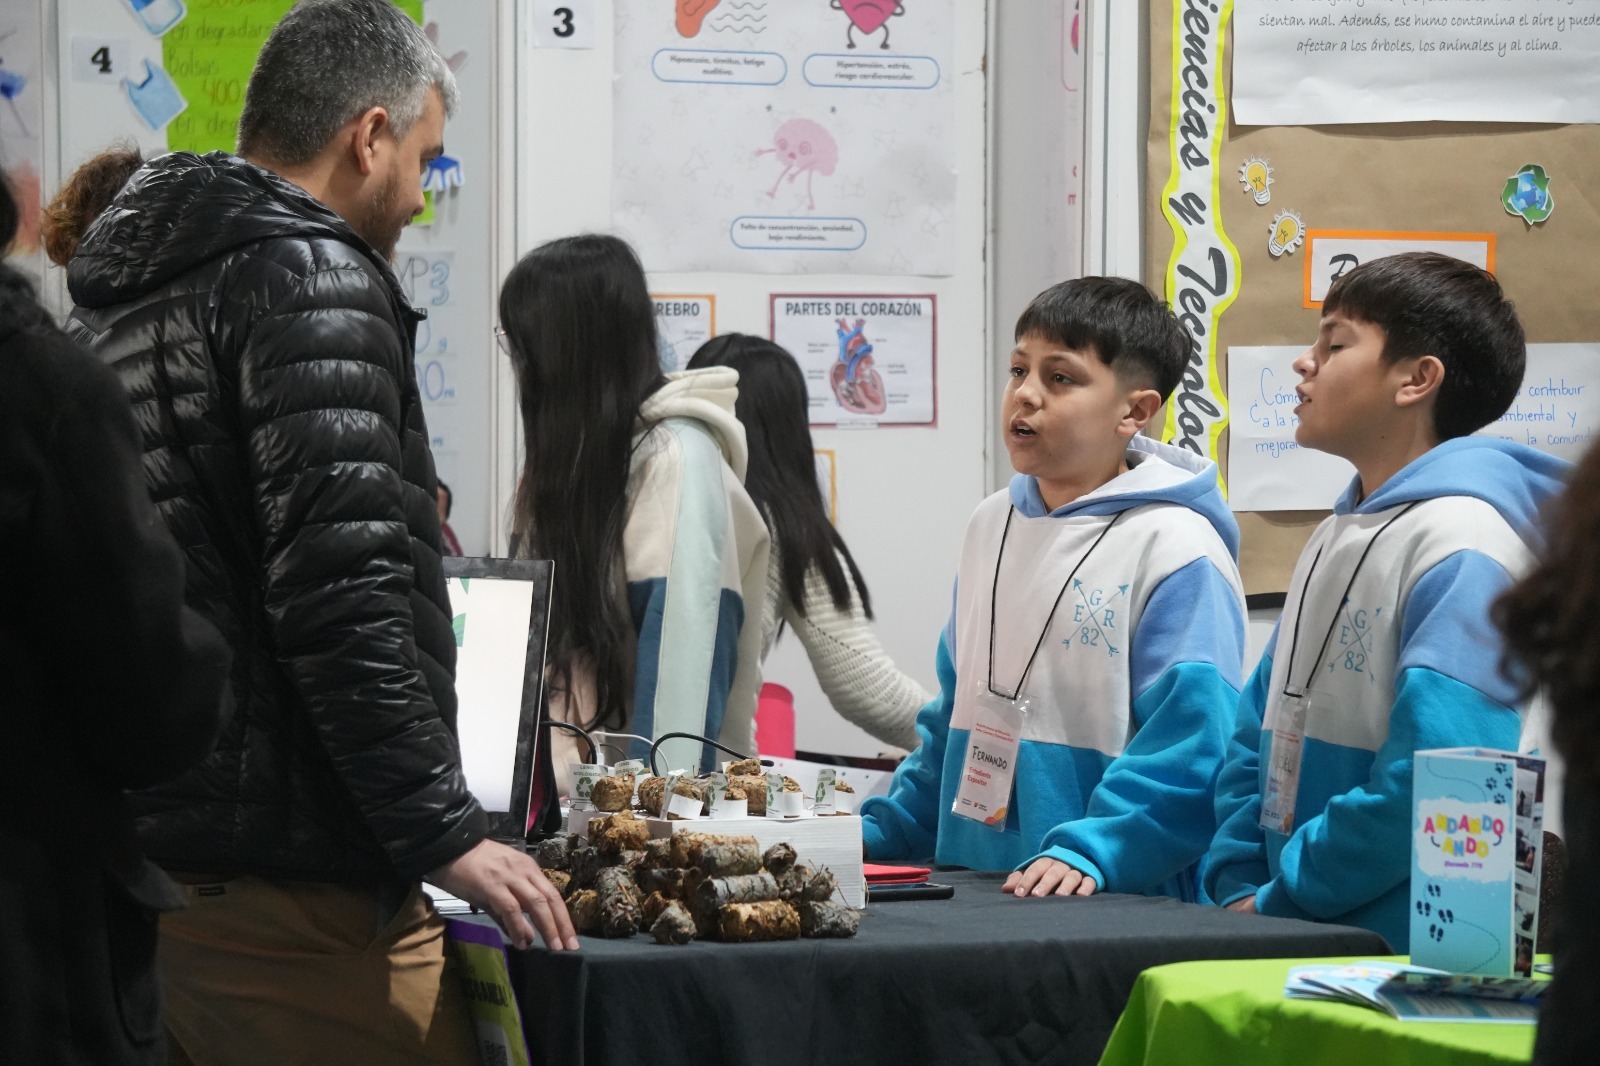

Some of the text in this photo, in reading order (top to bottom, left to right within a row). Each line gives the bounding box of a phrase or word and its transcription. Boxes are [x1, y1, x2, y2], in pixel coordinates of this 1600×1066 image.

[552, 7, 575, 38] 3
[1259, 13, 1305, 27] sientan
[1309, 13, 1335, 27] mal.
[1339, 13, 1390, 28] Además,
[1395, 16, 1411, 27] ese
[1415, 13, 1448, 27] humo
[1451, 13, 1515, 27] contamina
[1519, 13, 1529, 27] el
[1532, 13, 1554, 27] aire
[1557, 16, 1566, 32] y
[1296, 38, 1562, 58] afectar a los árboles, los animales y al clima.
[91, 46, 112, 73] 4
[1169, 192, 1207, 226] y
[785, 300, 922, 316] PARTES DEL CORAZÓN
[1528, 378, 1585, 398] contribuir
[1567, 411, 1577, 429] y
[1526, 428, 1537, 446] la
[1080, 626, 1100, 647] 82
[1344, 650, 1365, 673] 82
[972, 745, 1008, 770] FERNANDO
[1423, 812, 1505, 837] ANDANDO
[1442, 836, 1490, 858] ANDO
